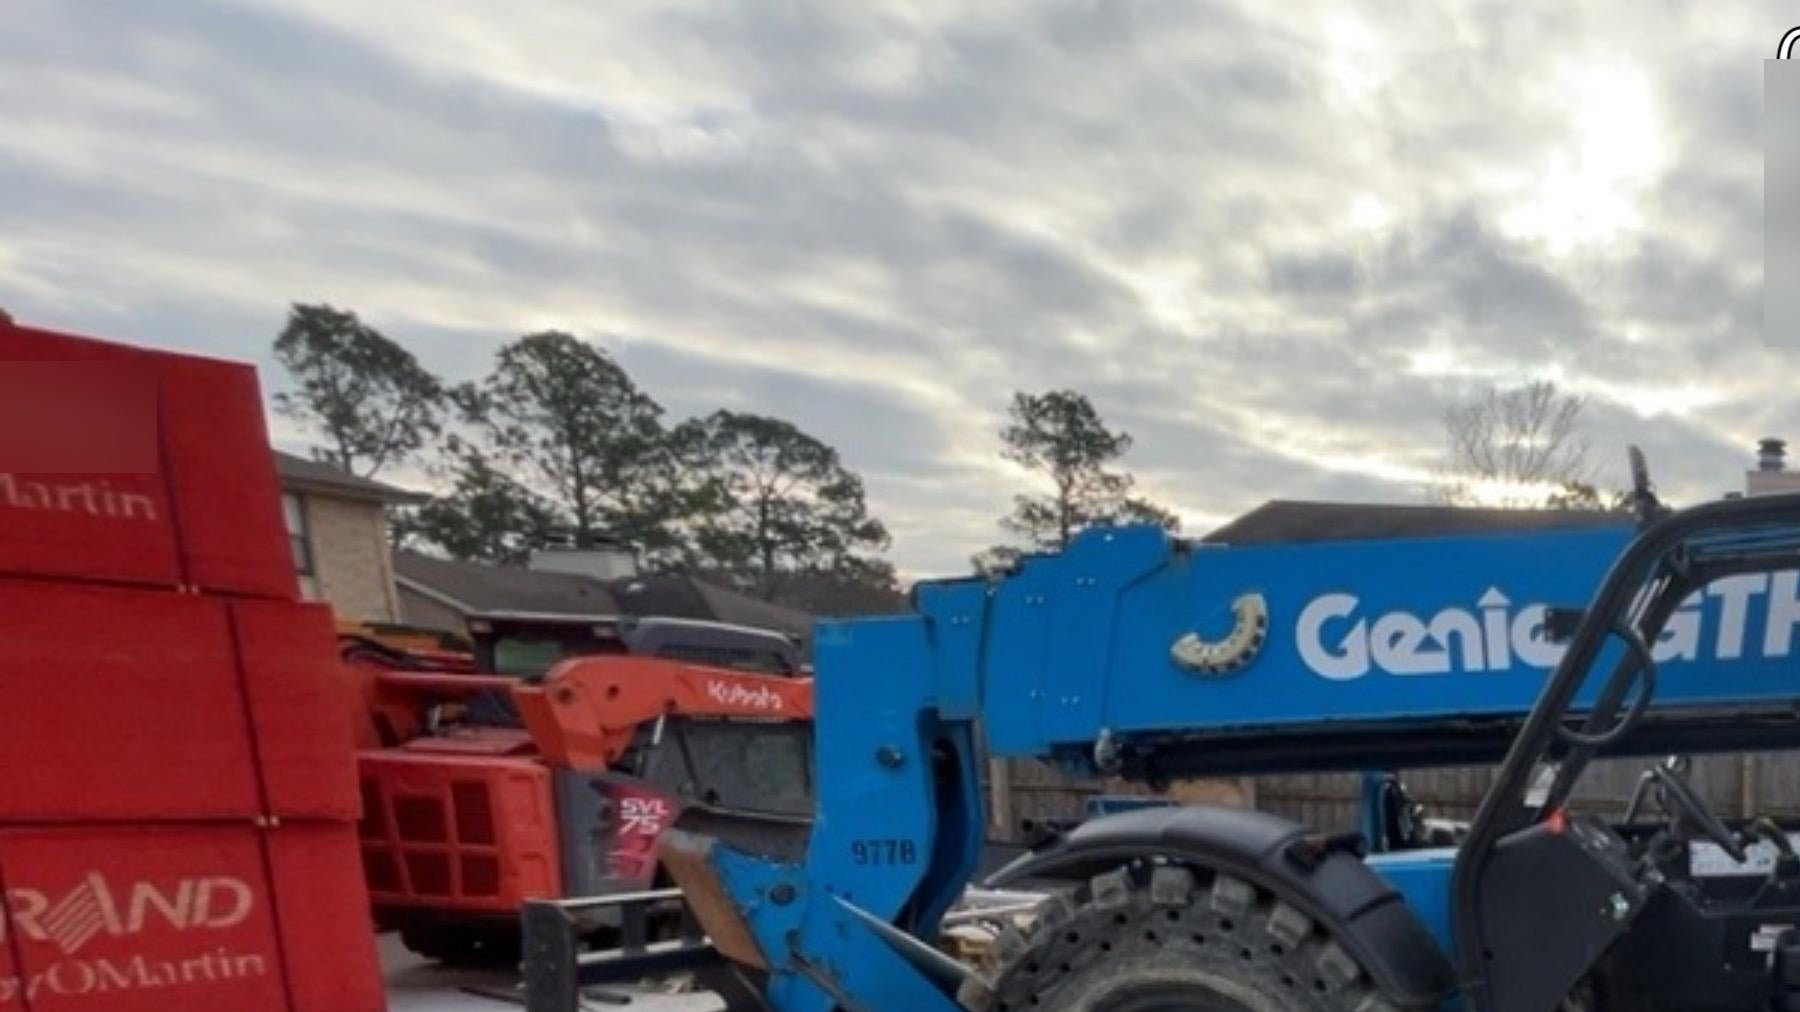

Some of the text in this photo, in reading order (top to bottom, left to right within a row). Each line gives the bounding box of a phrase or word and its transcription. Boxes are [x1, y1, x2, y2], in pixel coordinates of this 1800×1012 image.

[1295, 586, 1572, 681] Genie
[620, 797, 670, 816] SVL
[619, 814, 660, 836] 75
[852, 838, 915, 865] 9778
